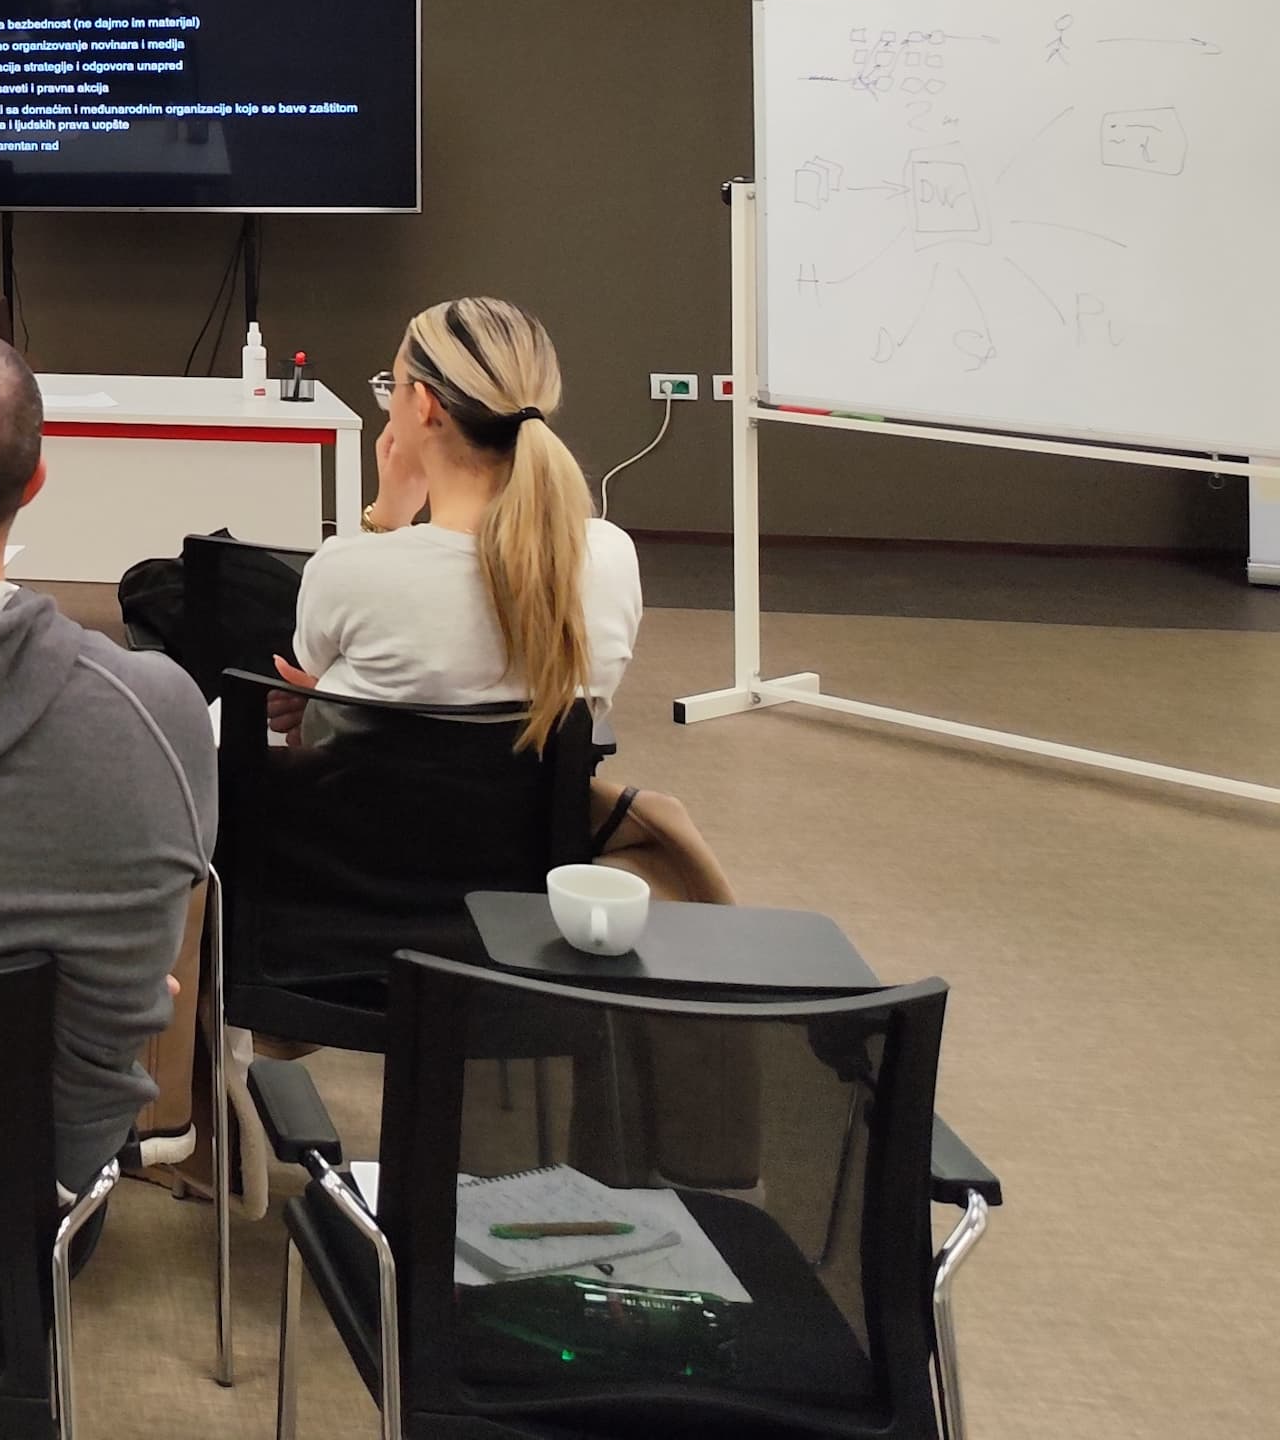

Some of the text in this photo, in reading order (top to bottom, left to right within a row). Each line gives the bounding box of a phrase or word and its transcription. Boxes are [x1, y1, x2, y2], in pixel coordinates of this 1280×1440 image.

[7, 18, 71, 30] bezbednost
[73, 18, 91, 31] (ne
[95, 17, 129, 31] dajmo
[131, 16, 146, 28] im
[148, 16, 200, 30] materijal)
[12, 39, 88, 53] organizovanje
[91, 39, 138, 50] novinara
[147, 38, 186, 51] medija
[23, 61, 74, 74] strategije
[82, 60, 134, 73] odgovora
[137, 60, 184, 73] unapred
[36, 84, 74, 96] pravna
[76, 82, 110, 96] akcija
[6, 106, 20, 115] sa
[21, 104, 72, 115] domaćim
[80, 104, 162, 115] međunarodnim
[165, 103, 232, 116] organizacije
[235, 103, 259, 116] koje
[262, 105, 276, 114] se
[278, 103, 307, 114] bave
[309, 102, 358, 114] zaštitom
[14, 120, 56, 132] ljudskih
[58, 121, 90, 132] prava
[92, 119, 130, 132] uopšte
[40, 140, 60, 151] rad
